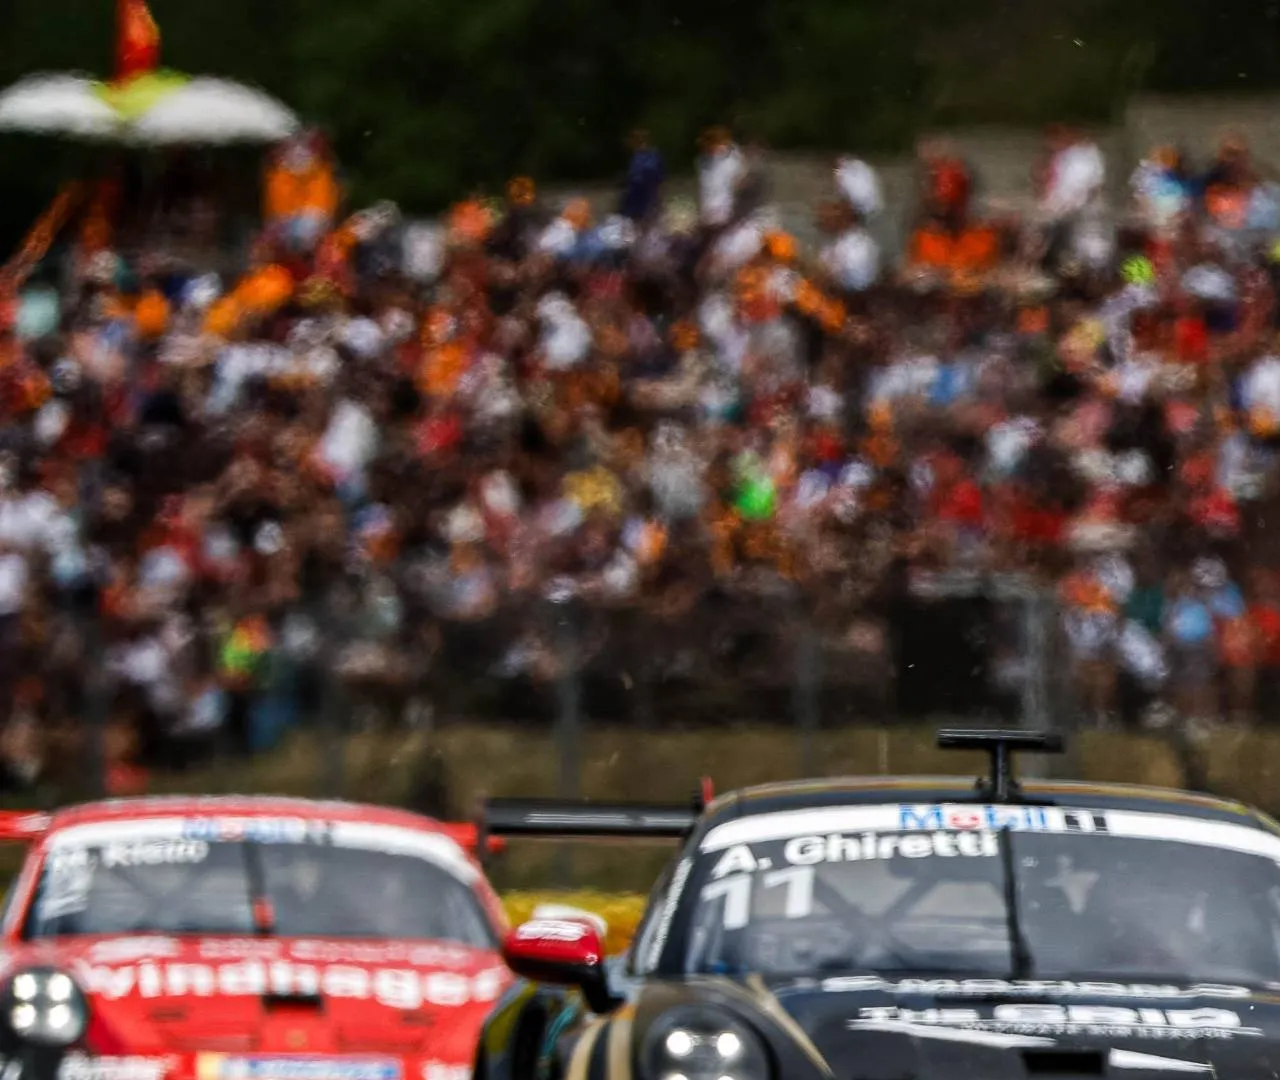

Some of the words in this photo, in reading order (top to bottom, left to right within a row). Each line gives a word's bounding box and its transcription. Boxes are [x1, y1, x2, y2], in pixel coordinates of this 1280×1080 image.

[900, 804, 1049, 830] Mobil
[711, 845, 774, 878] A.
[784, 829, 999, 866] Ghiretti
[702, 864, 818, 931] 11
